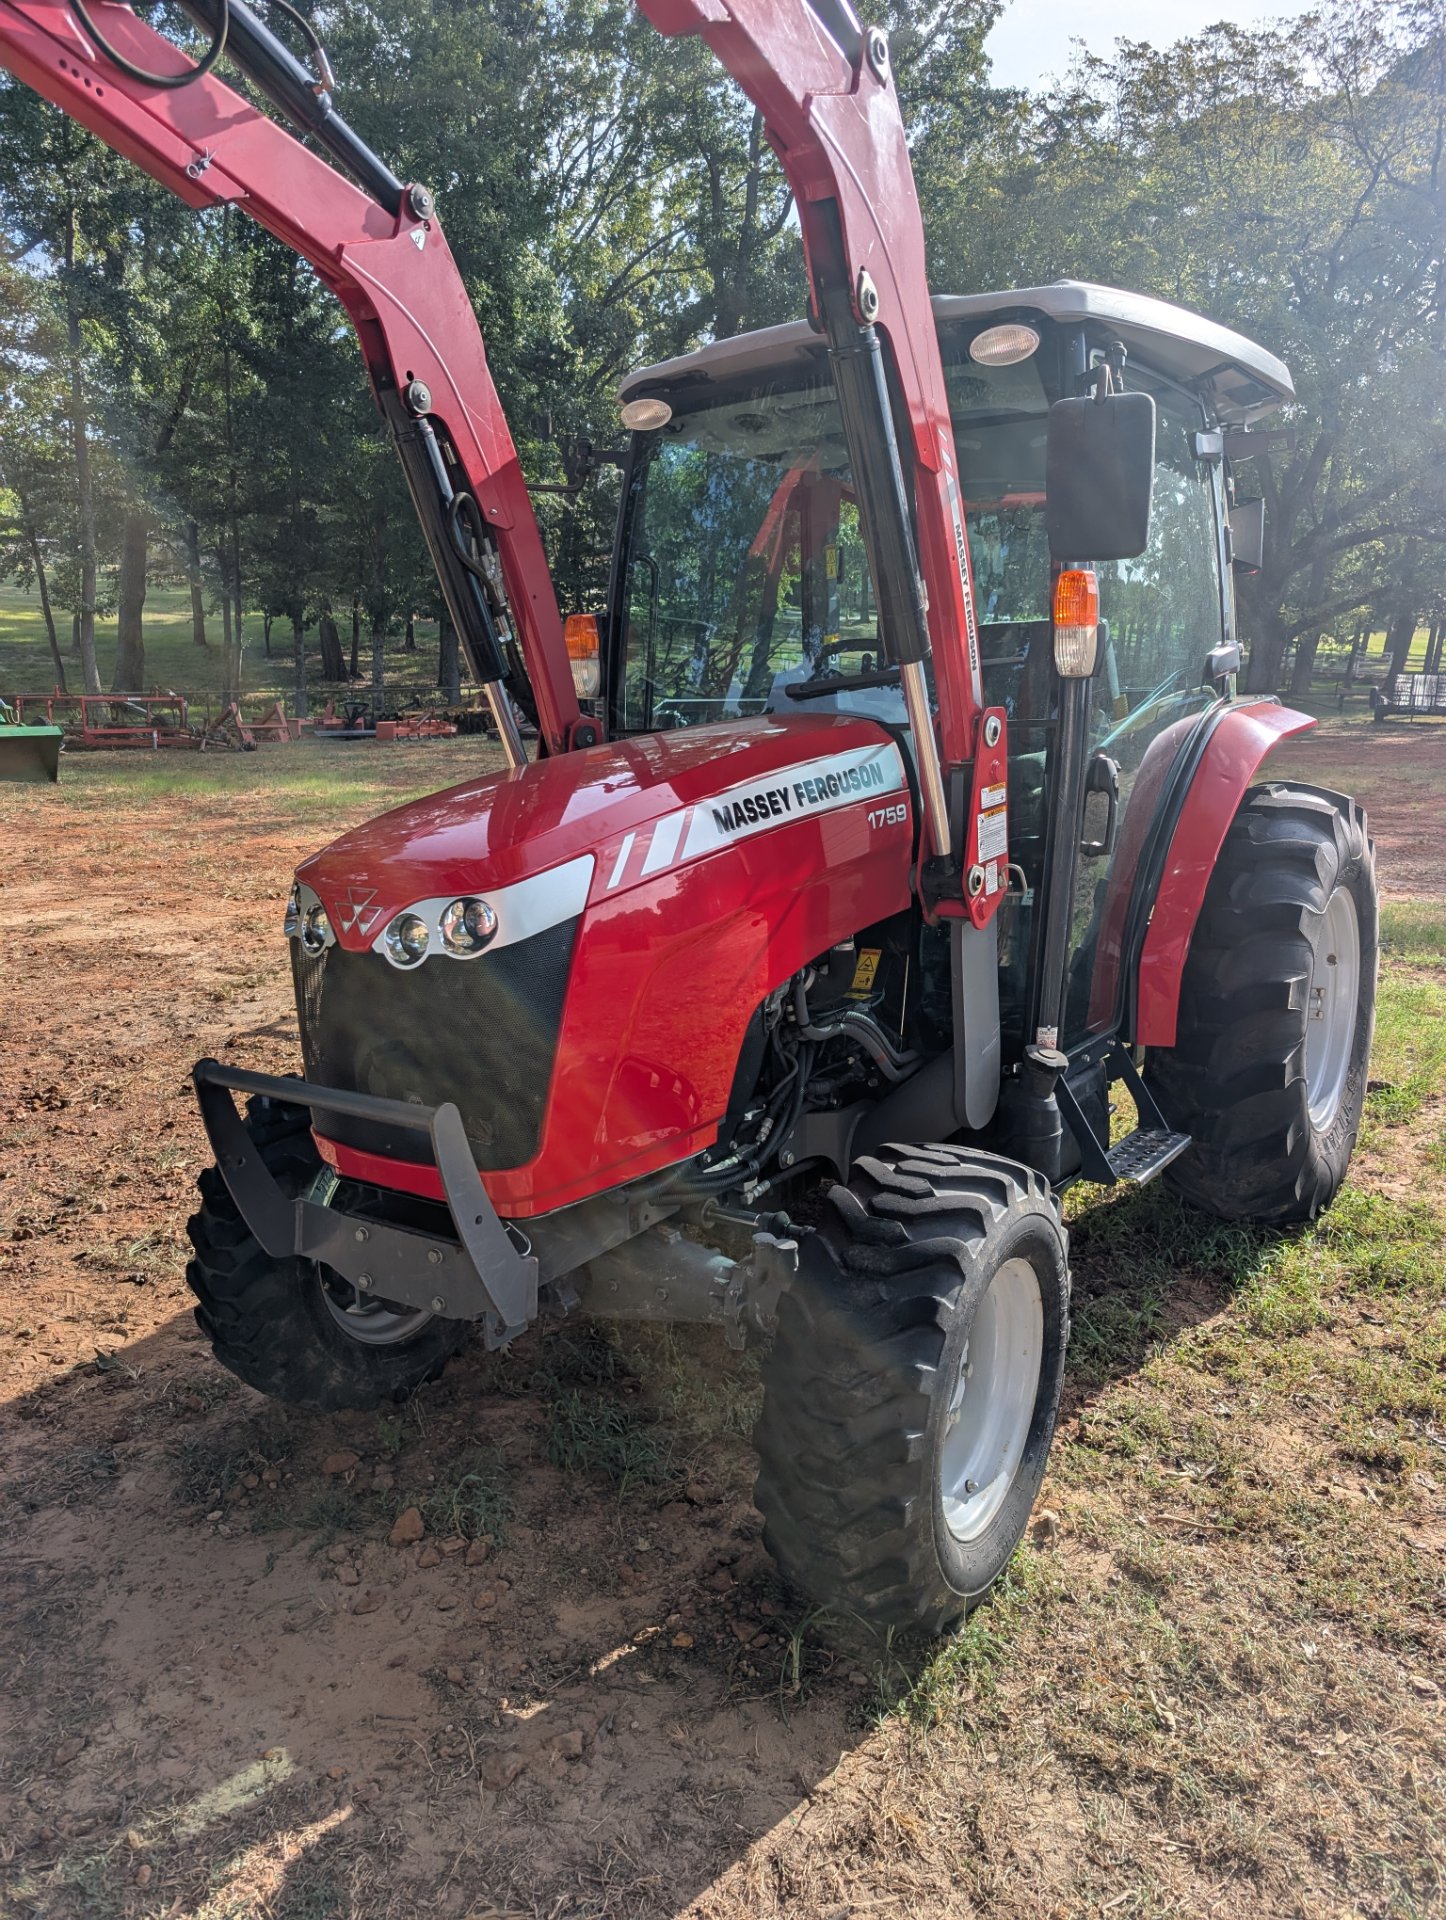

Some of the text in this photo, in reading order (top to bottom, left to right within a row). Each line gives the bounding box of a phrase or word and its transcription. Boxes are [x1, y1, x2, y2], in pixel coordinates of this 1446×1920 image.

[955, 525, 977, 671] MASSEY FERGUSON
[712, 762, 884, 834] MASSEY FERGUSON
[867, 803, 907, 830] 1759
